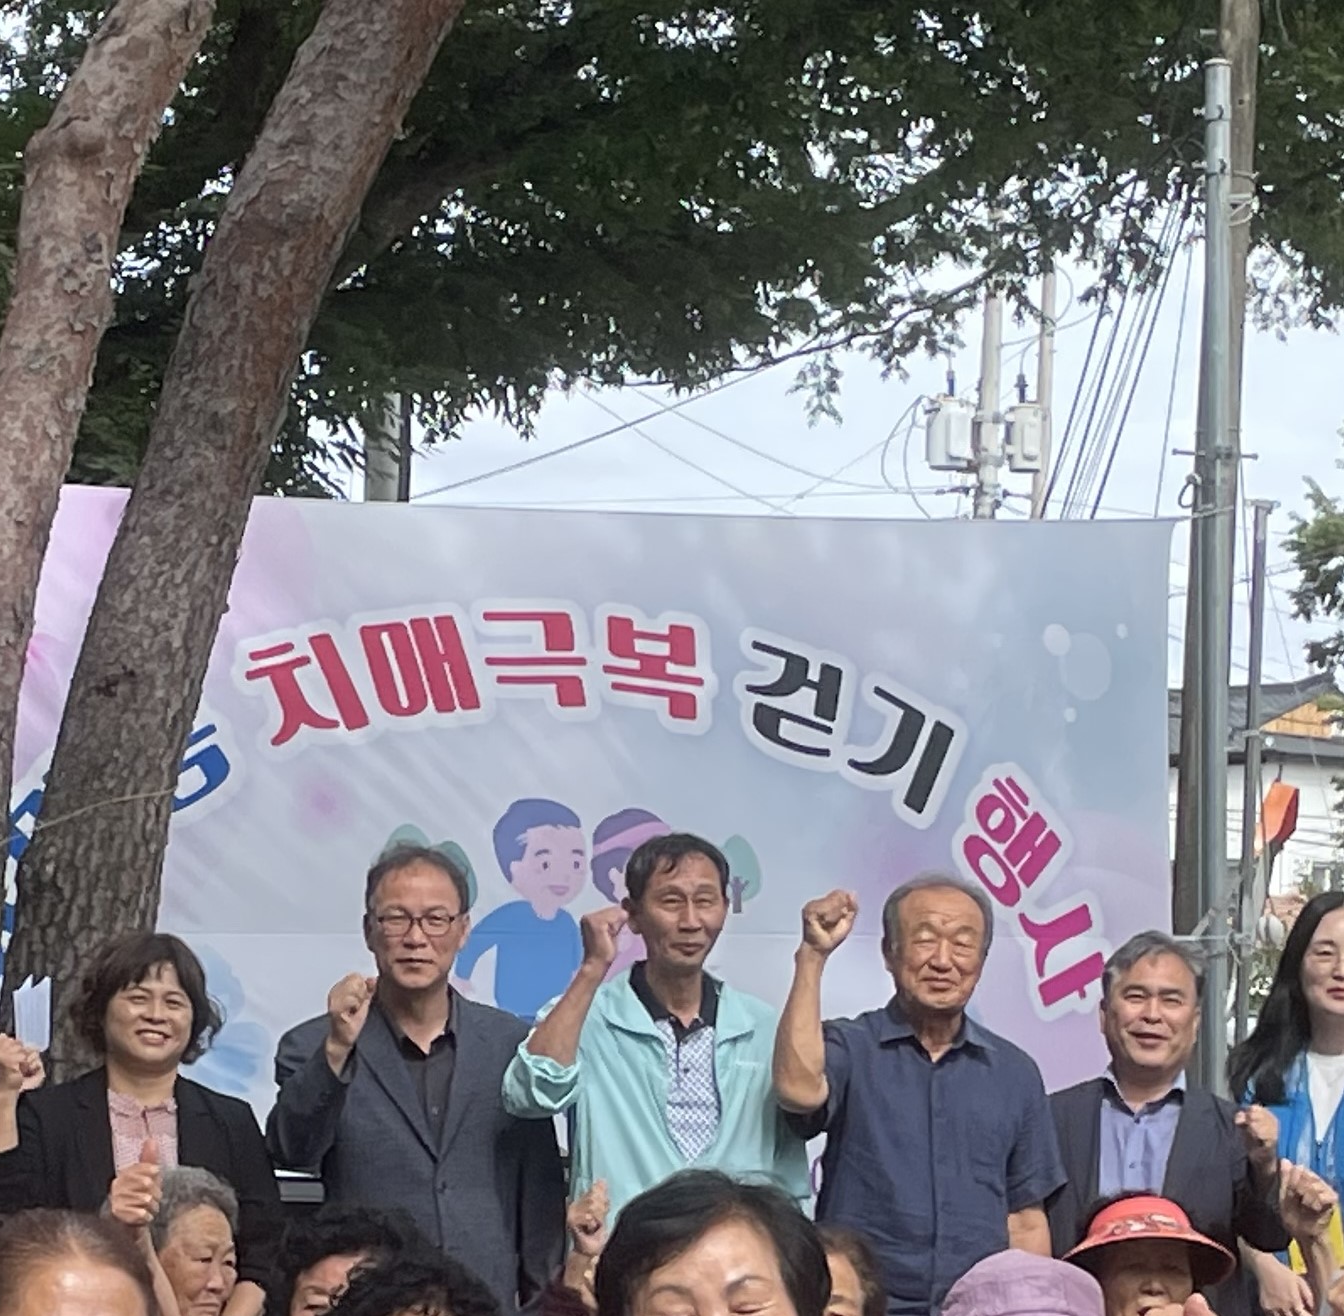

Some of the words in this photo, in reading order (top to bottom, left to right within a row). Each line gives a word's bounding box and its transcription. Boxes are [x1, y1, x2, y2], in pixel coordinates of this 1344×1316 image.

[245, 611, 705, 746] 치매극복
[745, 639, 955, 814] 걷기
[962, 776, 1106, 1008] 행사
